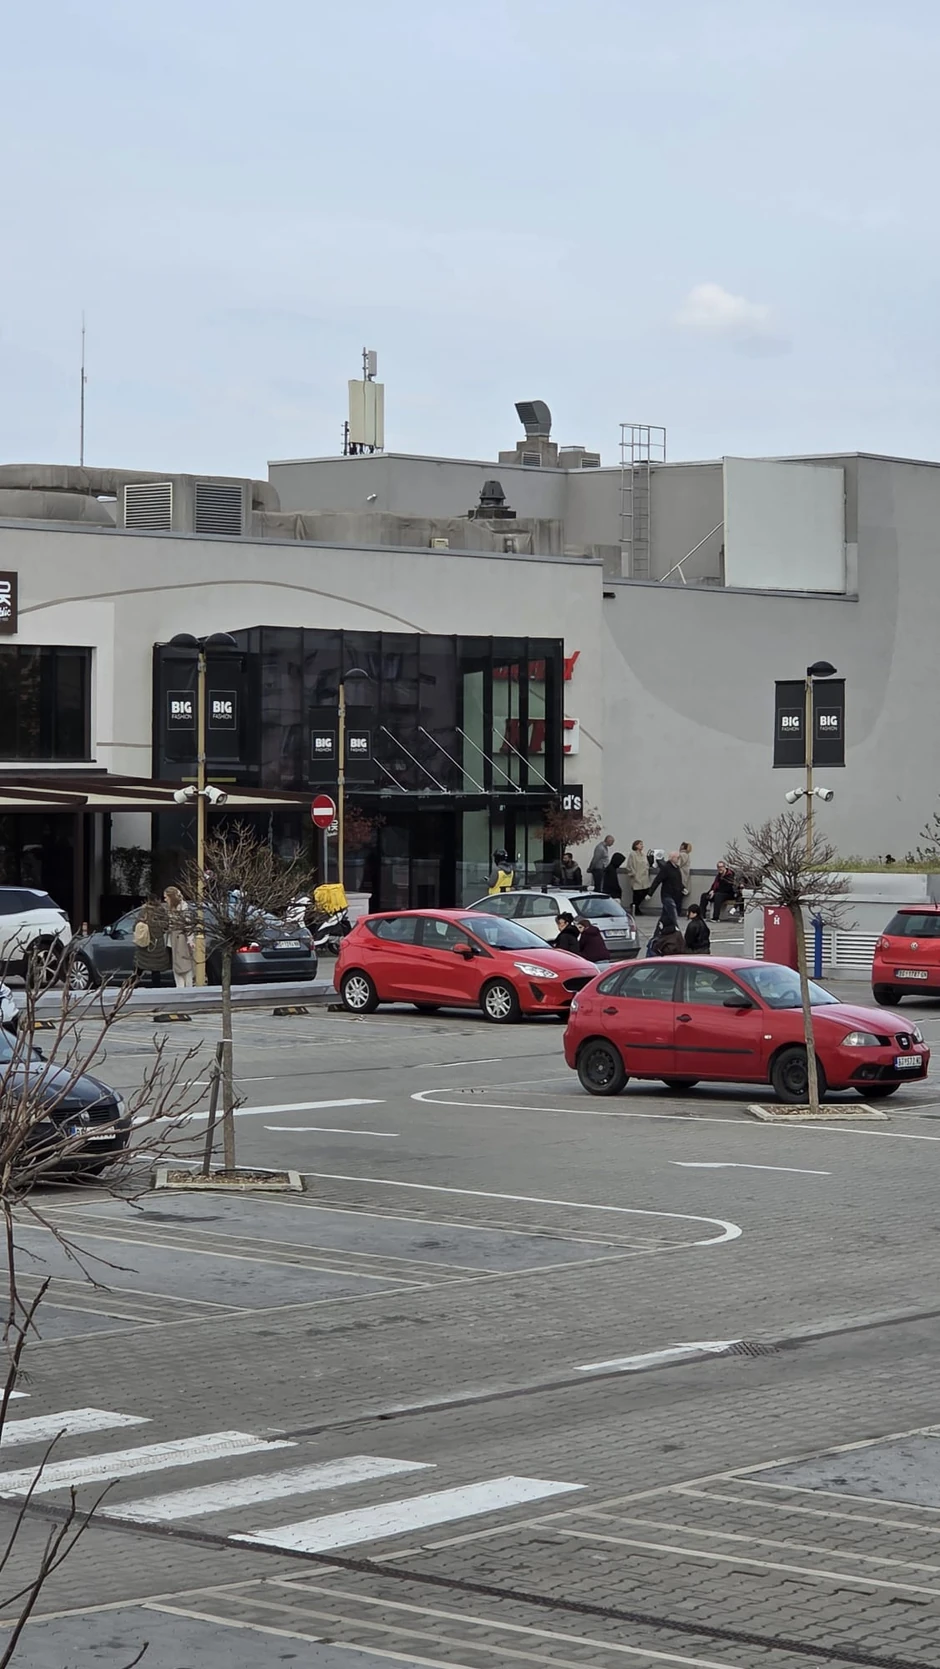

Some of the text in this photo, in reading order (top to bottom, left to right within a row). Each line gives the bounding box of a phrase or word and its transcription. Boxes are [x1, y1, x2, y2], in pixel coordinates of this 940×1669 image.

[171, 701, 192, 713] BIG
[213, 701, 232, 713] BIG
[782, 716, 800, 727] BIG
[820, 715, 838, 726] BIG
[315, 738, 332, 748] BIG
[350, 738, 367, 748] BIG
